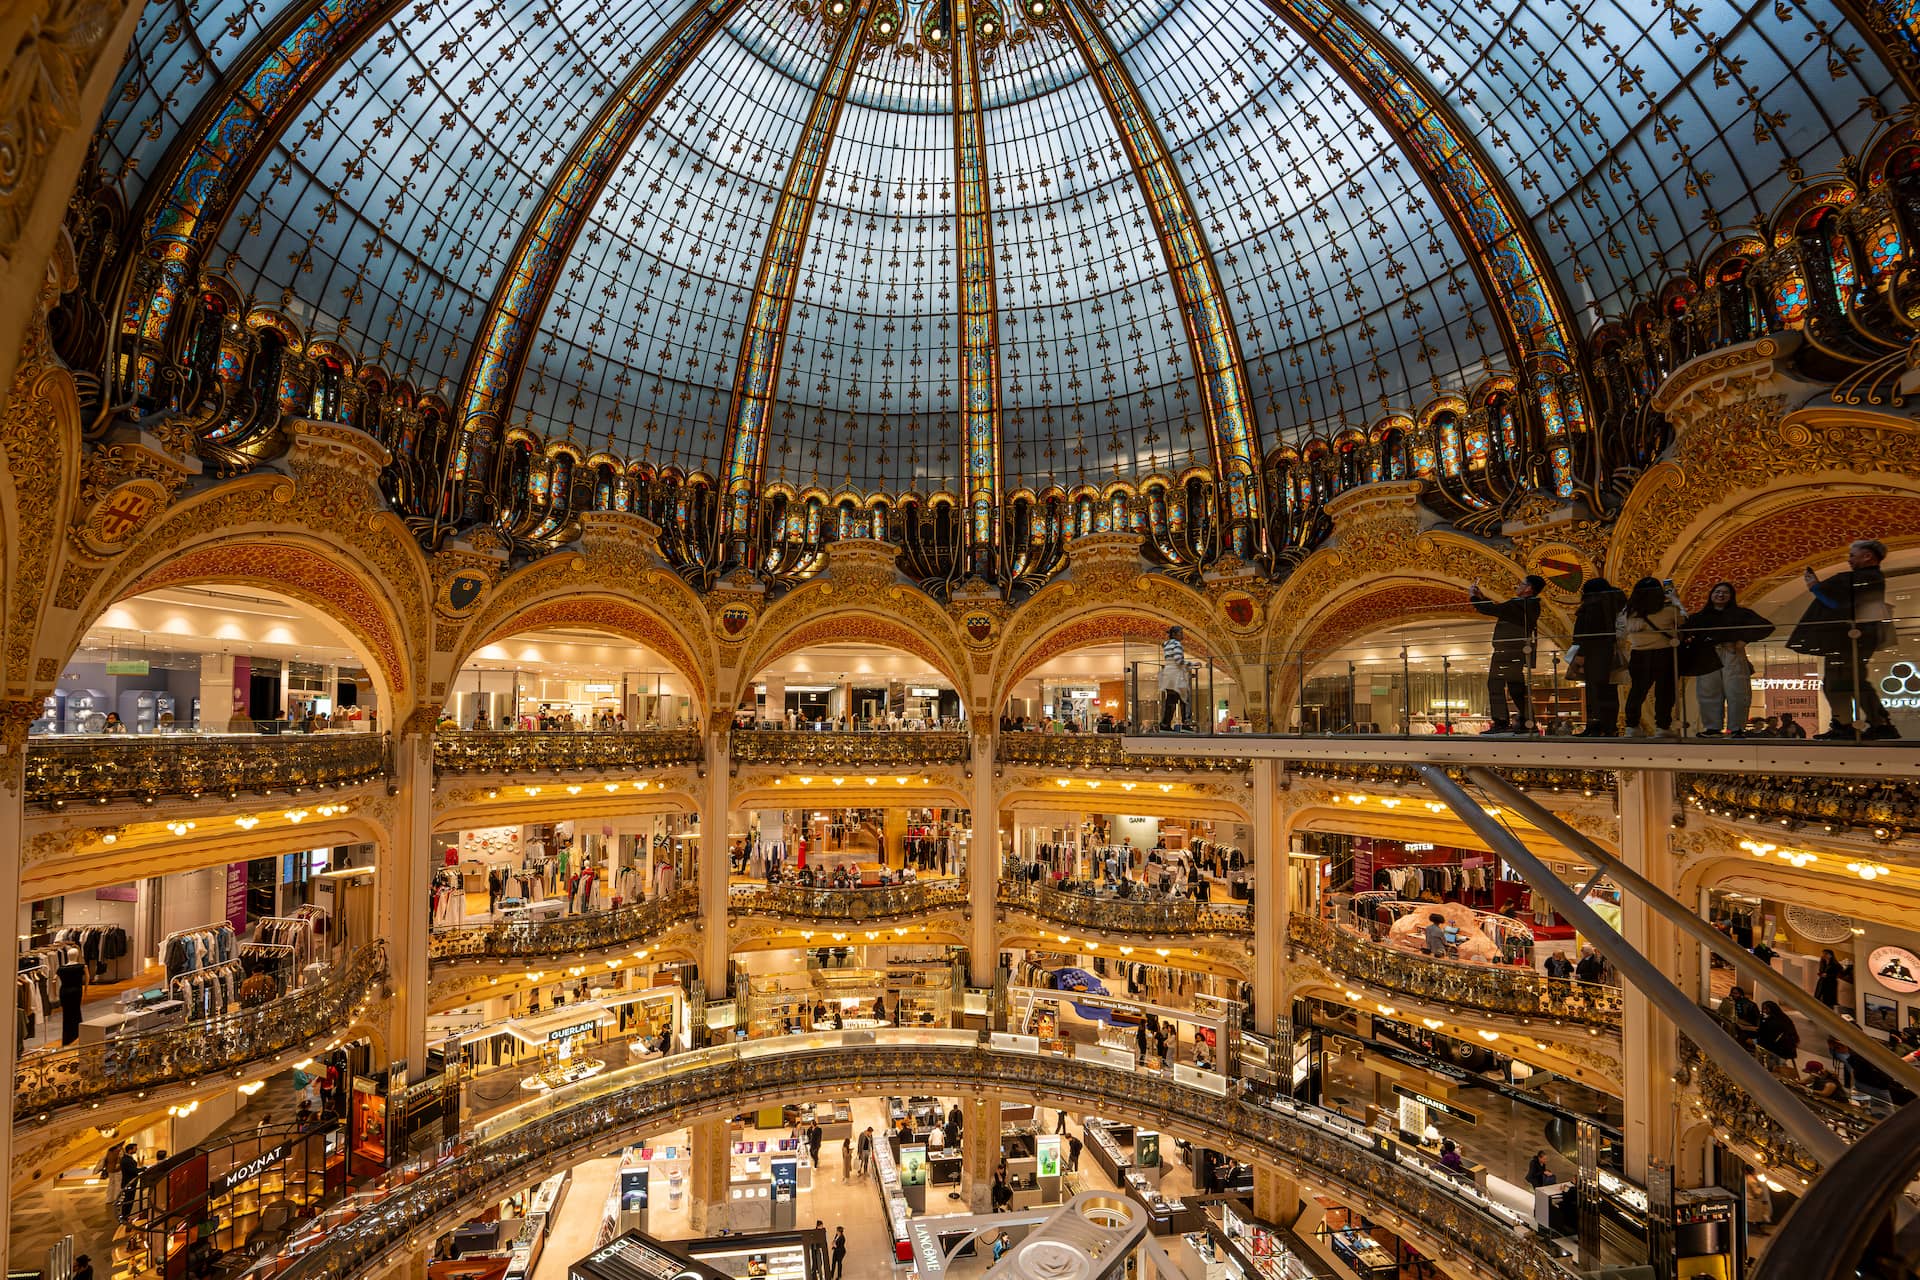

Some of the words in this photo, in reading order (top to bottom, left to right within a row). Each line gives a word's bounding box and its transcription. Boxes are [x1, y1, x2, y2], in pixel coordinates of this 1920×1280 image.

[1404, 843, 1434, 851] SYSTEM
[551, 1022, 594, 1040] GUERLAIN
[1416, 1094, 1450, 1112] CHANEL
[226, 1146, 282, 1187] MOYNAT
[590, 1239, 630, 1263] DIOR
[914, 1223, 941, 1272] LANCÔME
